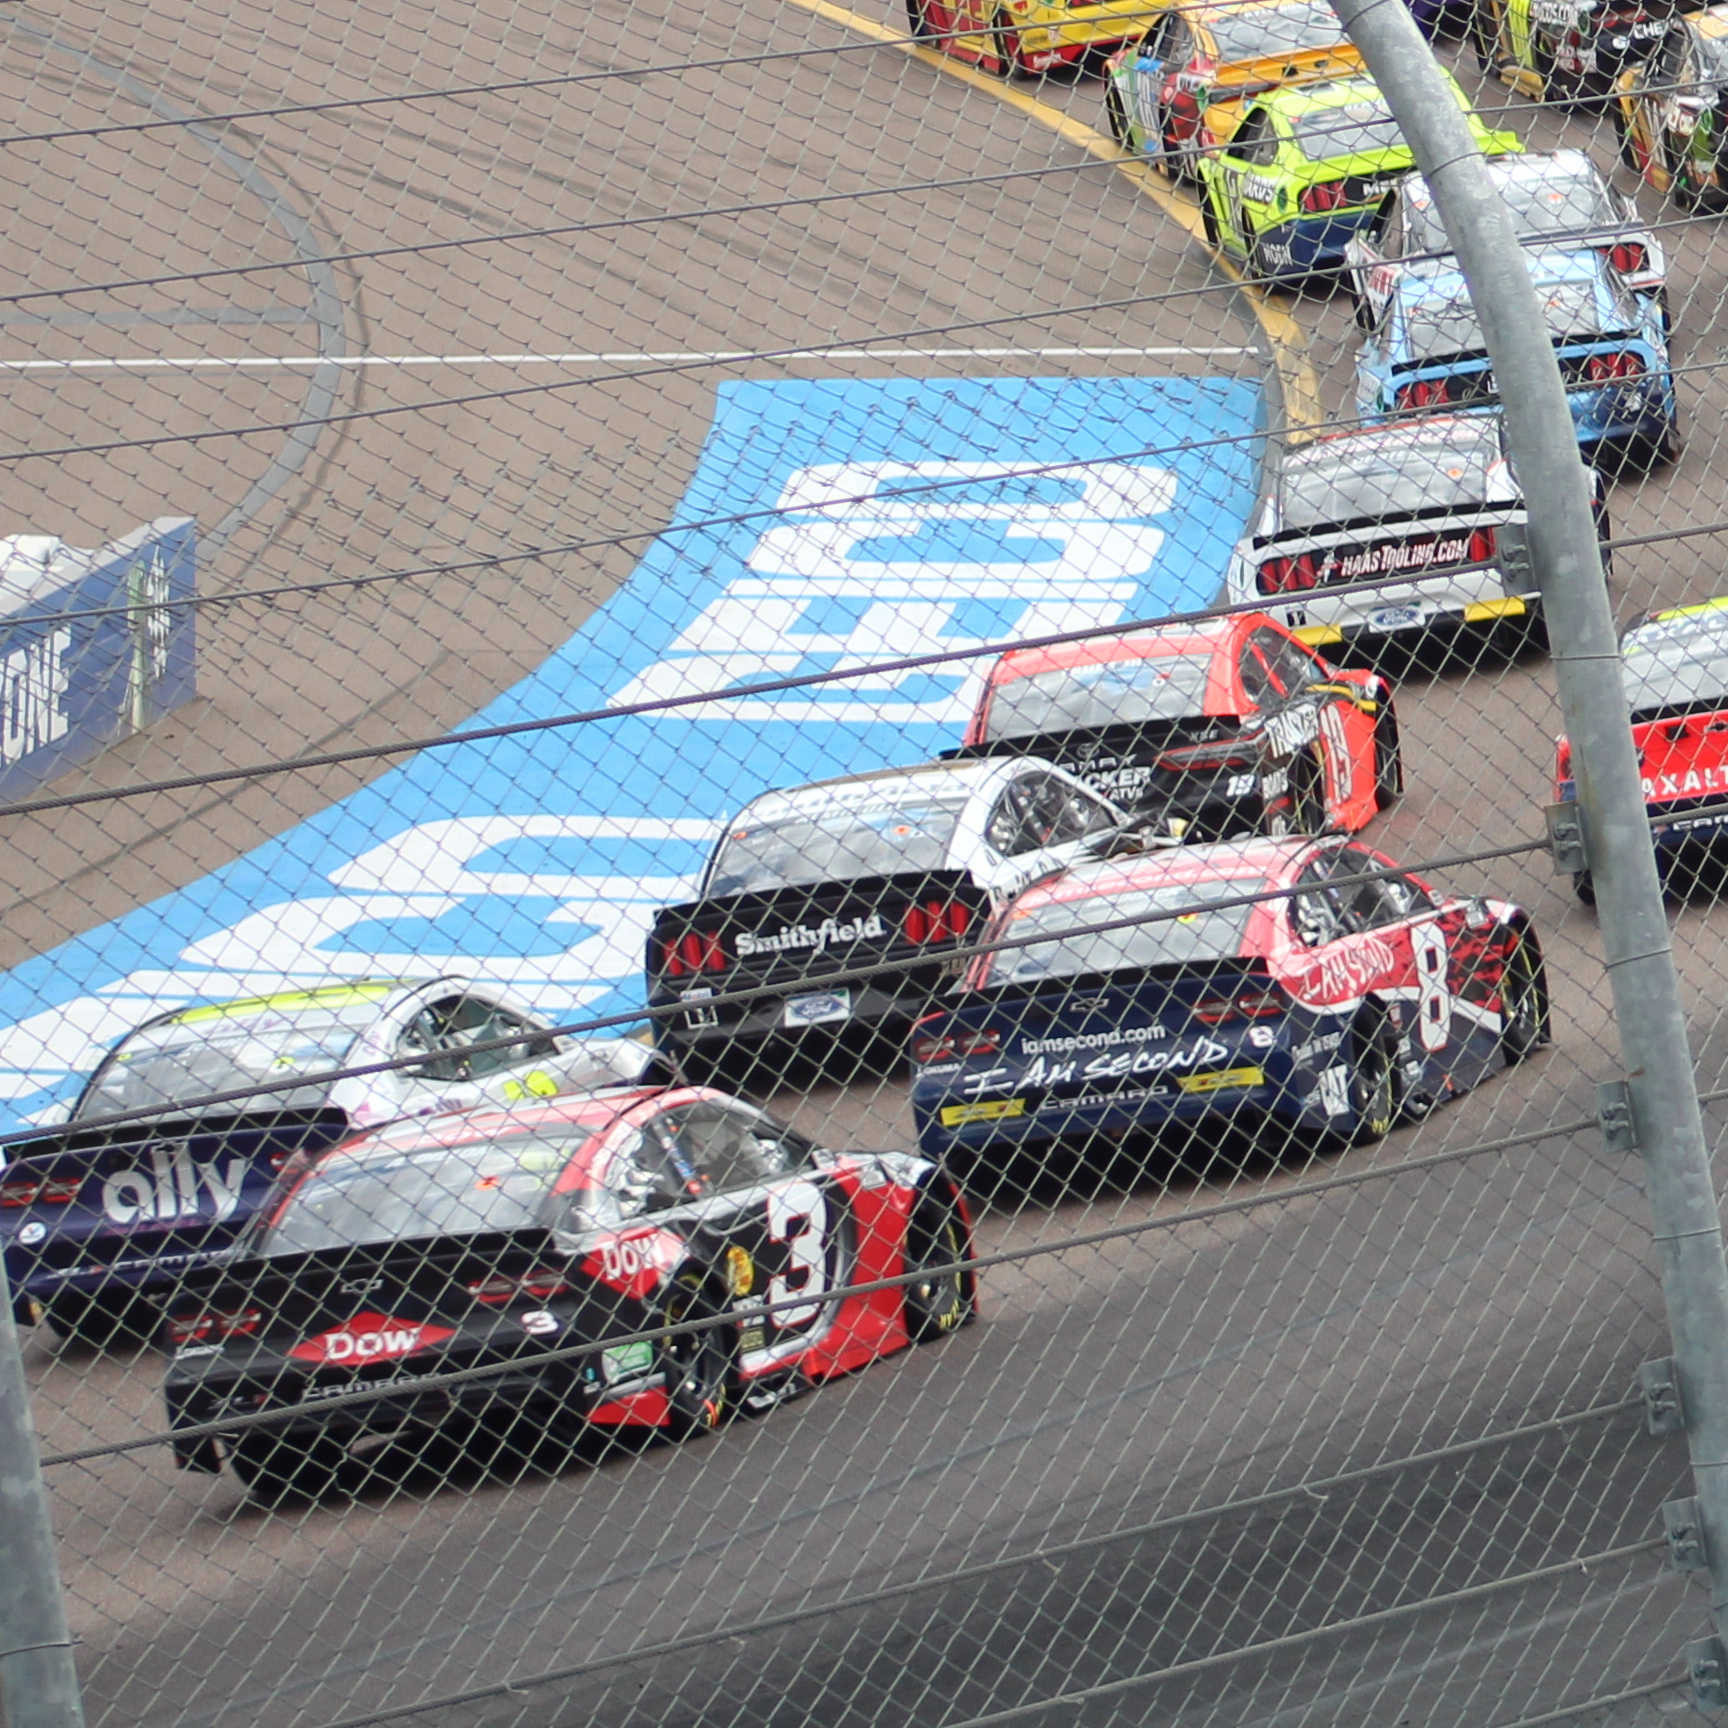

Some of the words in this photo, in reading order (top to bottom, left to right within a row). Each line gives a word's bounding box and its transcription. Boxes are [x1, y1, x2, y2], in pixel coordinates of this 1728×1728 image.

[735, 915, 884, 956] Smithfield
[1411, 921, 1450, 1052] 8
[1021, 1022, 1166, 1055] iamsecond.com
[1081, 1034, 1229, 1081] SECOND
[1249, 1025, 1275, 1049] 8
[102, 1140, 247, 1224] ally
[767, 1180, 828, 1330] 3
[521, 1310, 559, 1335] 3
